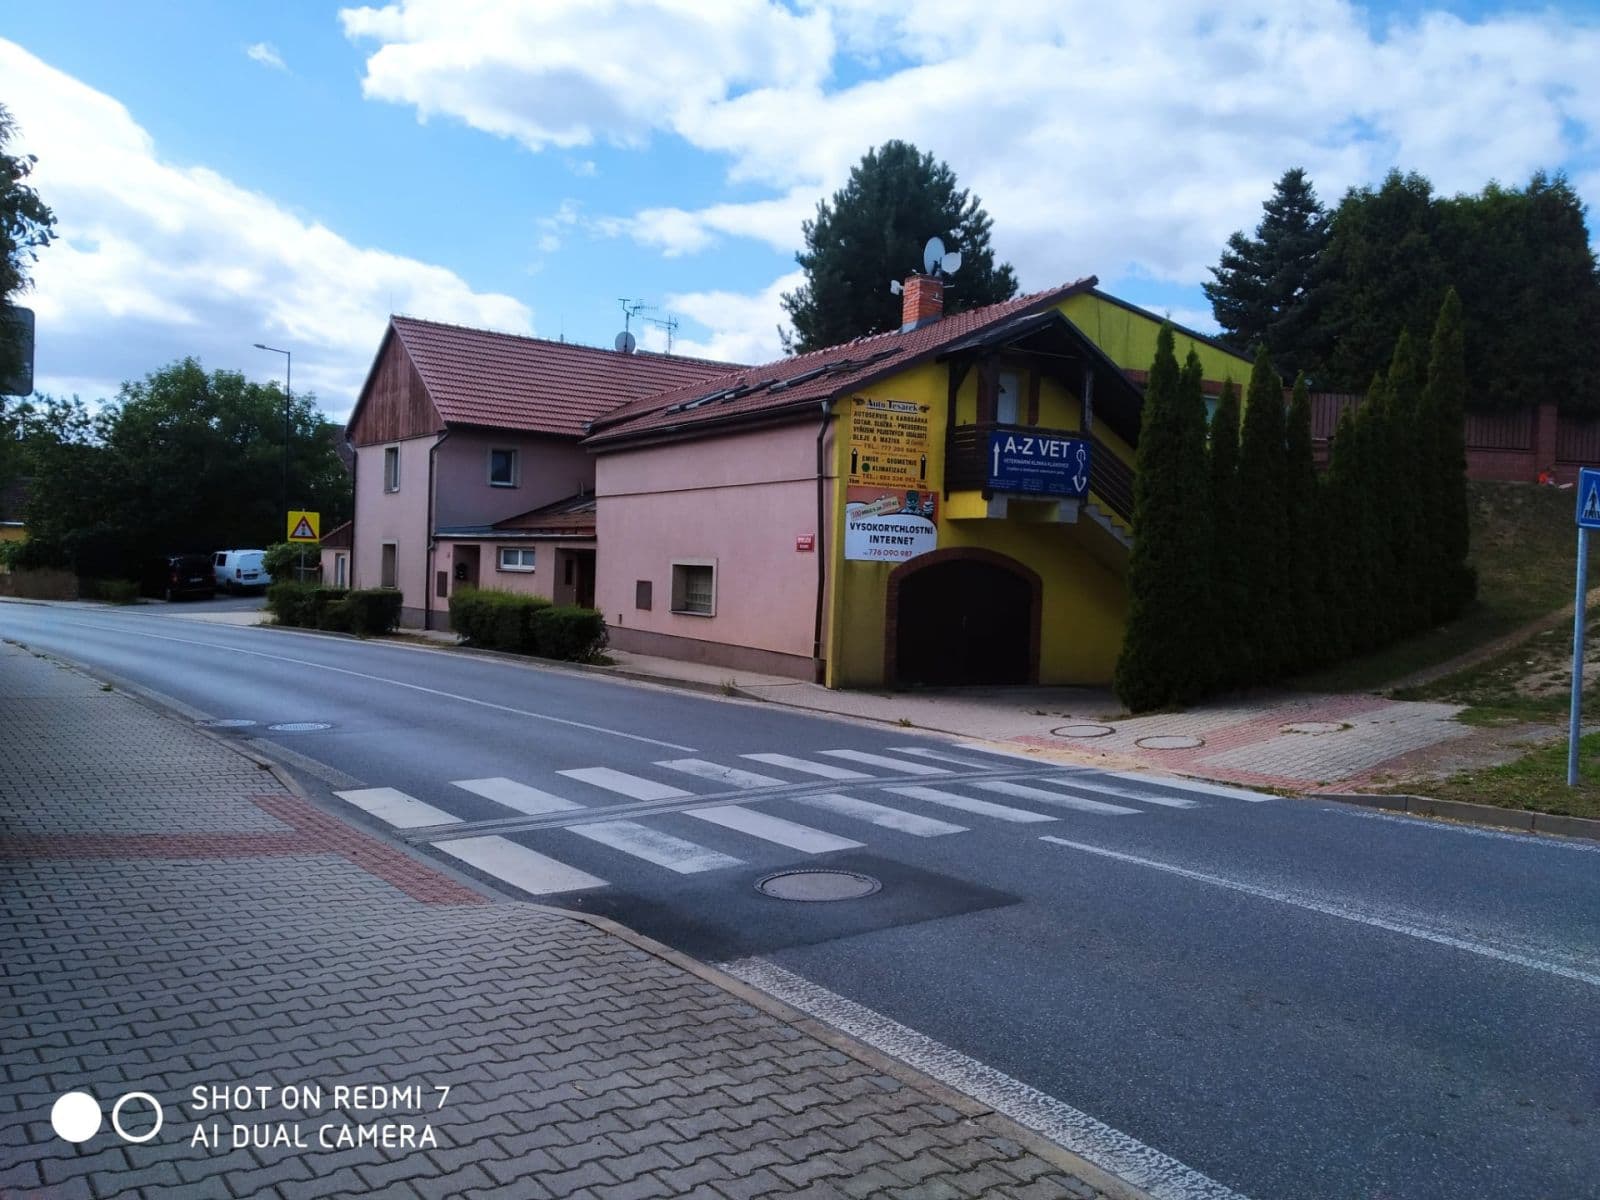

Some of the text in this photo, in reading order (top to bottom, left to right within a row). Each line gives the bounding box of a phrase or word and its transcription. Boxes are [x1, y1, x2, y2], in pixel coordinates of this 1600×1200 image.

[867, 399, 885, 408] Auto
[853, 411, 888, 420] AUTOSERVIS
[1004, 436, 1071, 458] A-Z VET
[861, 455, 879, 463] EMISE
[850, 523, 933, 535] VYSOKORYCHLOSTNÍ
[870, 535, 914, 545] INTERNET
[868, 548, 882, 556] 776
[883, 549, 899, 557] 090
